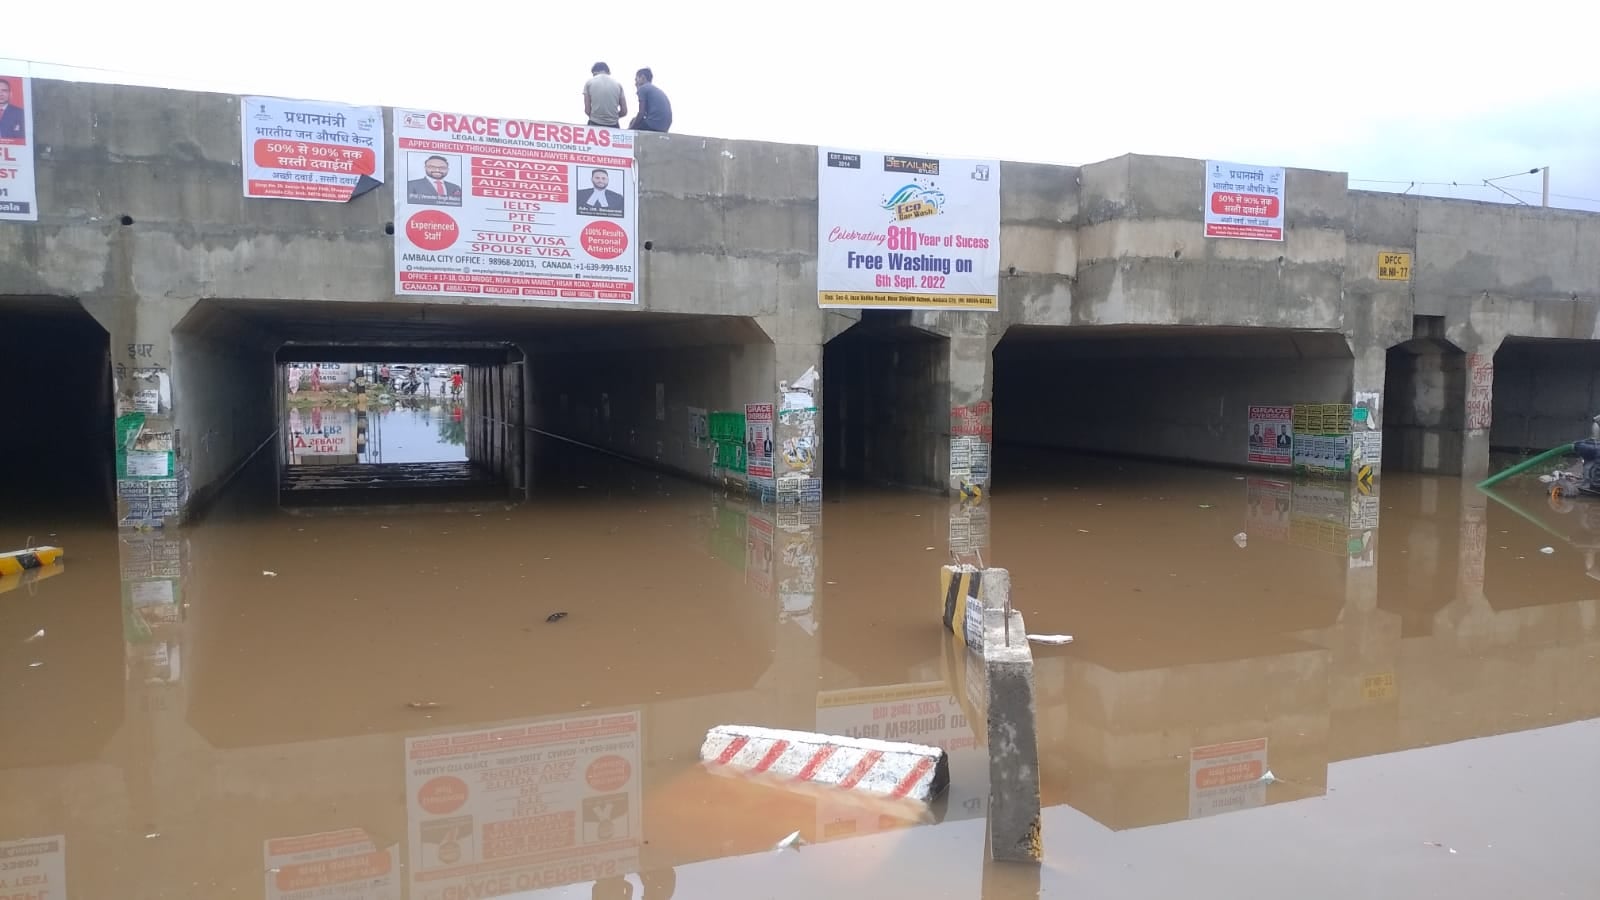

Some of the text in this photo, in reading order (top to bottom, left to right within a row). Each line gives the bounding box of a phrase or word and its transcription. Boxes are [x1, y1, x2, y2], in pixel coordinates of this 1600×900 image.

[284, 111, 346, 128] प्रधानमंत्री
[255, 125, 374, 147] भारतीय जन औषधि केन्द्र
[426, 113, 500, 136] GRACE
[505, 120, 610, 147] OVERSEAS
[486, 138, 534, 147] IMMIGRATION
[536, 140, 577, 151] SOLUTIONS
[0, 147, 16, 161] L
[267, 143, 363, 160] 50% से 90% तक
[409, 140, 429, 148] APPLY
[432, 141, 465, 151] DIRECTLY
[466, 144, 500, 154] THROUGH
[502, 147, 539, 157] CANADIAN
[541, 150, 568, 160] LAWYER
[600, 156, 627, 165] MEMBER
[278, 156, 307, 168] सस्ती
[481, 159, 559, 172] CANADA
[481, 168, 561, 182] UK USA
[1229, 170, 1264, 181] प्रधानमंत्री
[479, 179, 563, 192] AUSTRALIA
[483, 189, 560, 201] EUROPE
[1218, 195, 1235, 203] 50%
[1243, 197, 1259, 205] 90%
[0, 202, 20, 211] ala
[503, 200, 541, 211] IELTS
[897, 203, 921, 214] Eco
[509, 212, 536, 222] PTE
[913, 209, 933, 218] Wash
[410, 221, 455, 231] Experienced
[513, 224, 532, 233] PR
[424, 232, 441, 240] Staff
[477, 232, 566, 246] STUDY VISA
[585, 228, 624, 238] 100% Results
[828, 225, 989, 251] Celebrating 8th Year of Sucess
[588, 237, 621, 245] Personal
[471, 243, 571, 257] SPOUSE VISA
[587, 246, 624, 254] Attention
[402, 253, 435, 262] AMBALA
[437, 255, 453, 263] CITY
[456, 256, 481, 264] OFFICE
[542, 260, 572, 269] CANADA
[848, 251, 973, 275] Free Washing on
[1385, 255, 1402, 265] DFCC
[592, 281, 614, 289] AMBALA
[875, 274, 946, 290] 6th Sept. 2022
[748, 405, 771, 413] GRACE
